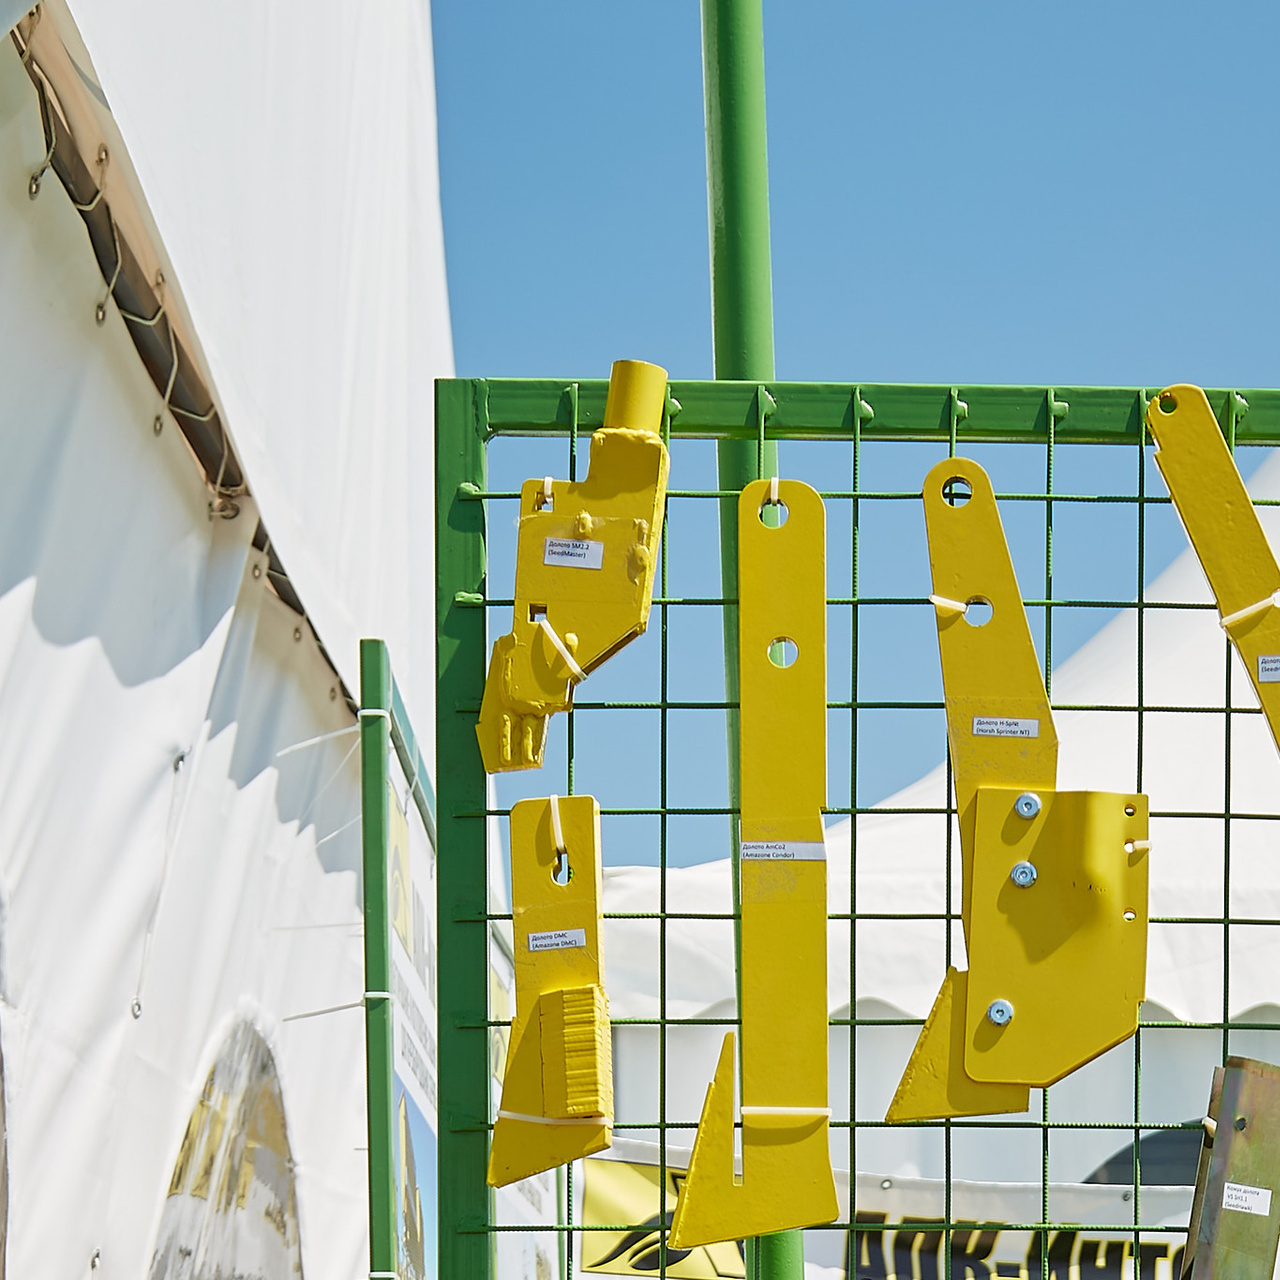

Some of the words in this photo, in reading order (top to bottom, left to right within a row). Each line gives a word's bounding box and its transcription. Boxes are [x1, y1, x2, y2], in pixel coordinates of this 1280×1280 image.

[548, 550, 586, 559] (SeedMaster)
[743, 843, 764, 851] Долото
[532, 940, 560, 950] (Amazone
[560, 939, 577, 947] DMC)
